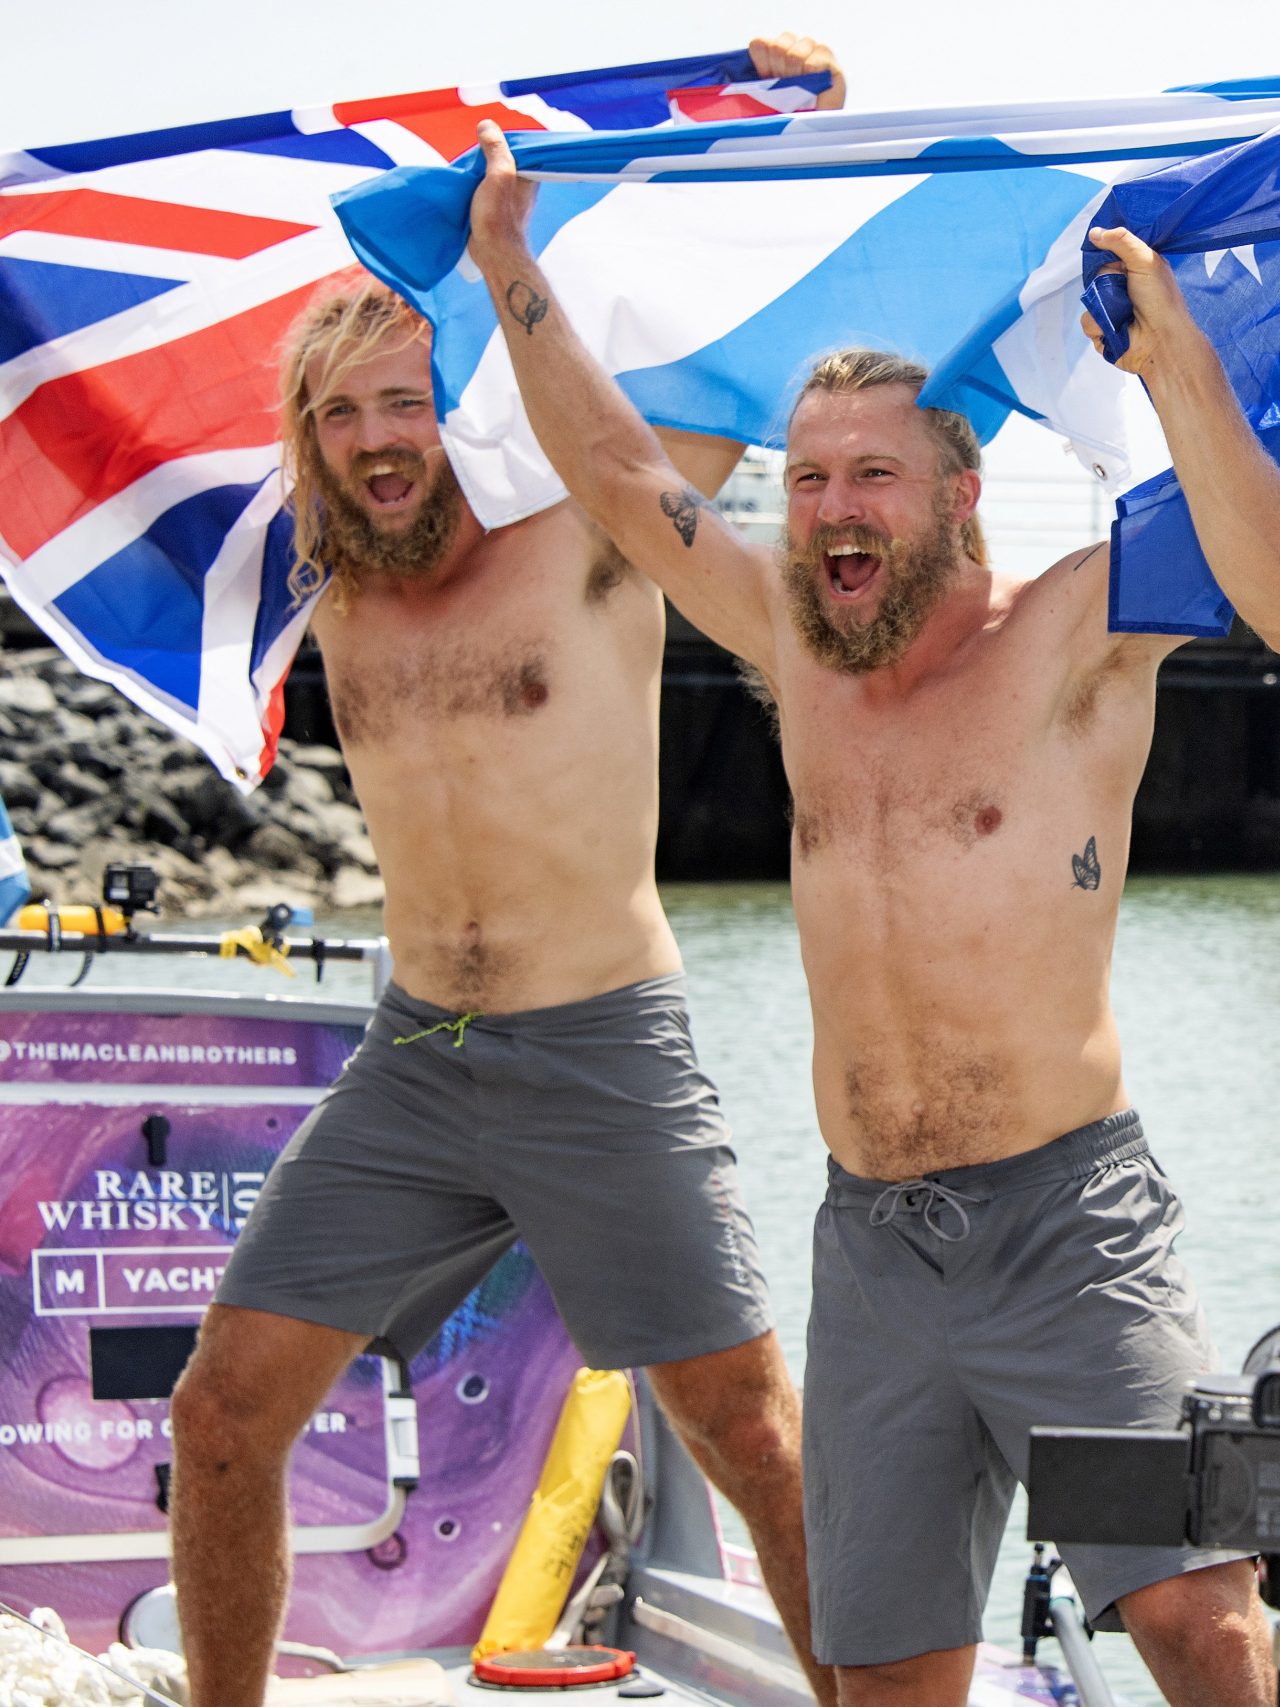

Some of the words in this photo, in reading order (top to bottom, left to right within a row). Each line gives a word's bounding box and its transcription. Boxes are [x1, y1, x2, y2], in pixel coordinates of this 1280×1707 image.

[95, 1170, 219, 1200] RARE
[37, 1200, 219, 1231] WHISKY
[56, 1269, 85, 1294] M
[101, 1418, 153, 1440] FOR
